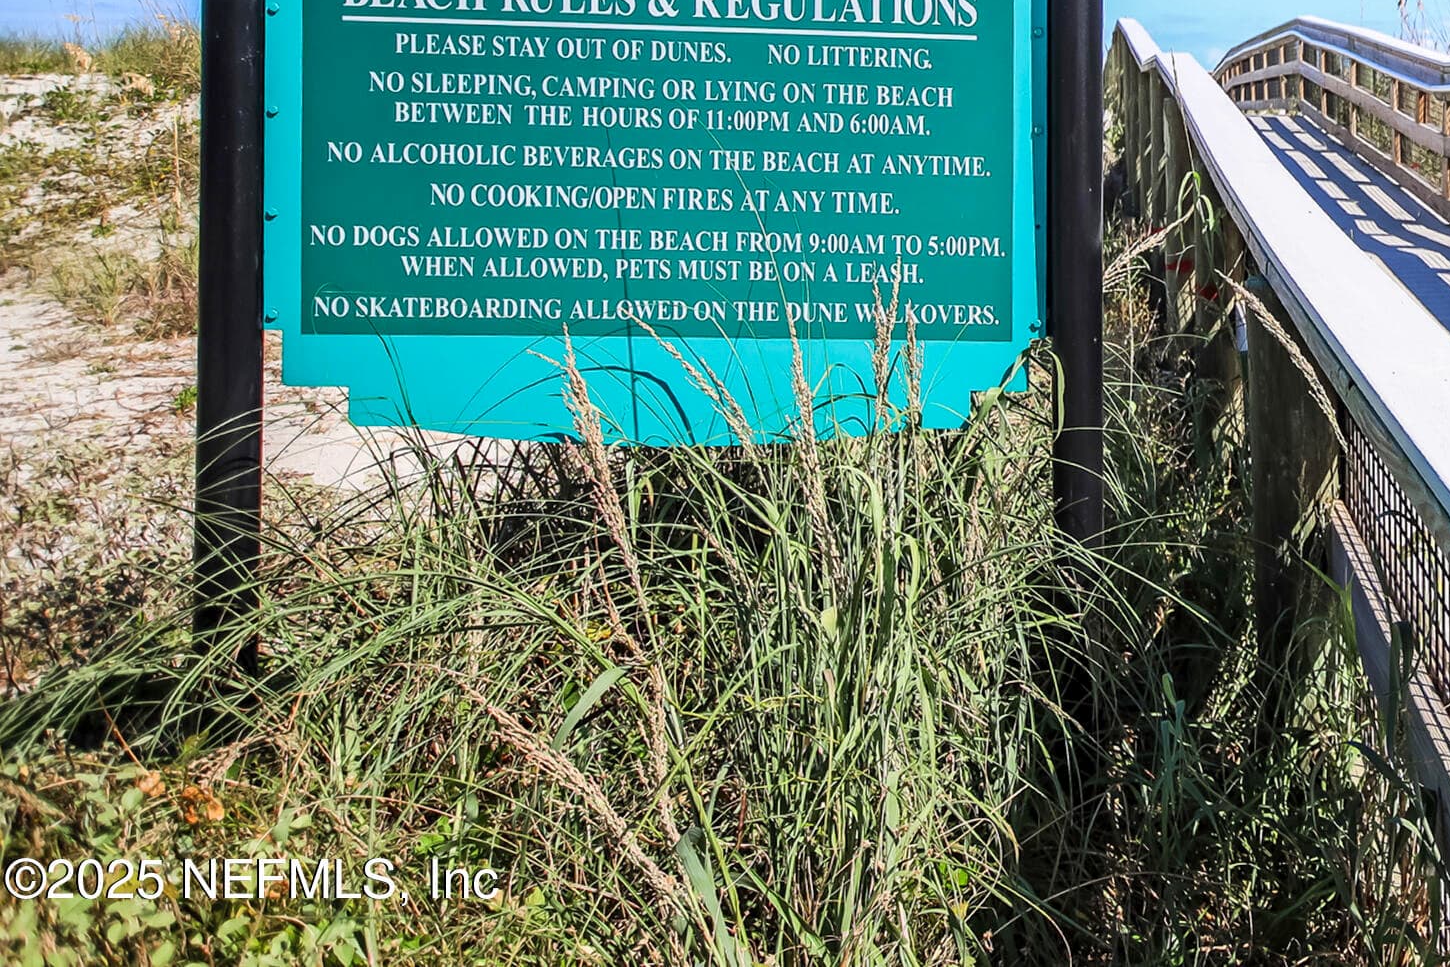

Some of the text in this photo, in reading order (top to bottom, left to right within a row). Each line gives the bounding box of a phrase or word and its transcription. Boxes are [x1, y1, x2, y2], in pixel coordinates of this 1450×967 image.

[395, 33, 732, 63] PLEASE STAY OUT OF DUNES.
[768, 44, 932, 70] NO LITTERING.
[369, 71, 953, 107] NO SLEEPING, CAMPING OR LYING ON THE BEACH
[394, 102, 931, 136] BETWEEN THE HOURS OF 11:00PM AND 6:00AM.
[327, 142, 991, 177] NO ALCOHOLIC BEVERAGES ON THE BEACH AT ANYTIME.
[430, 183, 900, 214] NO COOKING/OPEN FIRES AT ANY TIME.
[310, 225, 1005, 257] NO DOGS ALLOWED ON THE BEACH FROM 9:00AM TO 5:00PM.
[401, 256, 924, 284] WHEN ALLOWED, PETS MUST BE ON A LEASH.
[314, 296, 349, 317] NO
[355, 297, 562, 319] SKATEBOARDING
[569, 299, 688, 321] ALLOWED
[693, 300, 726, 322] ON
[734, 301, 779, 322] THE
[786, 302, 847, 323] DUNE
